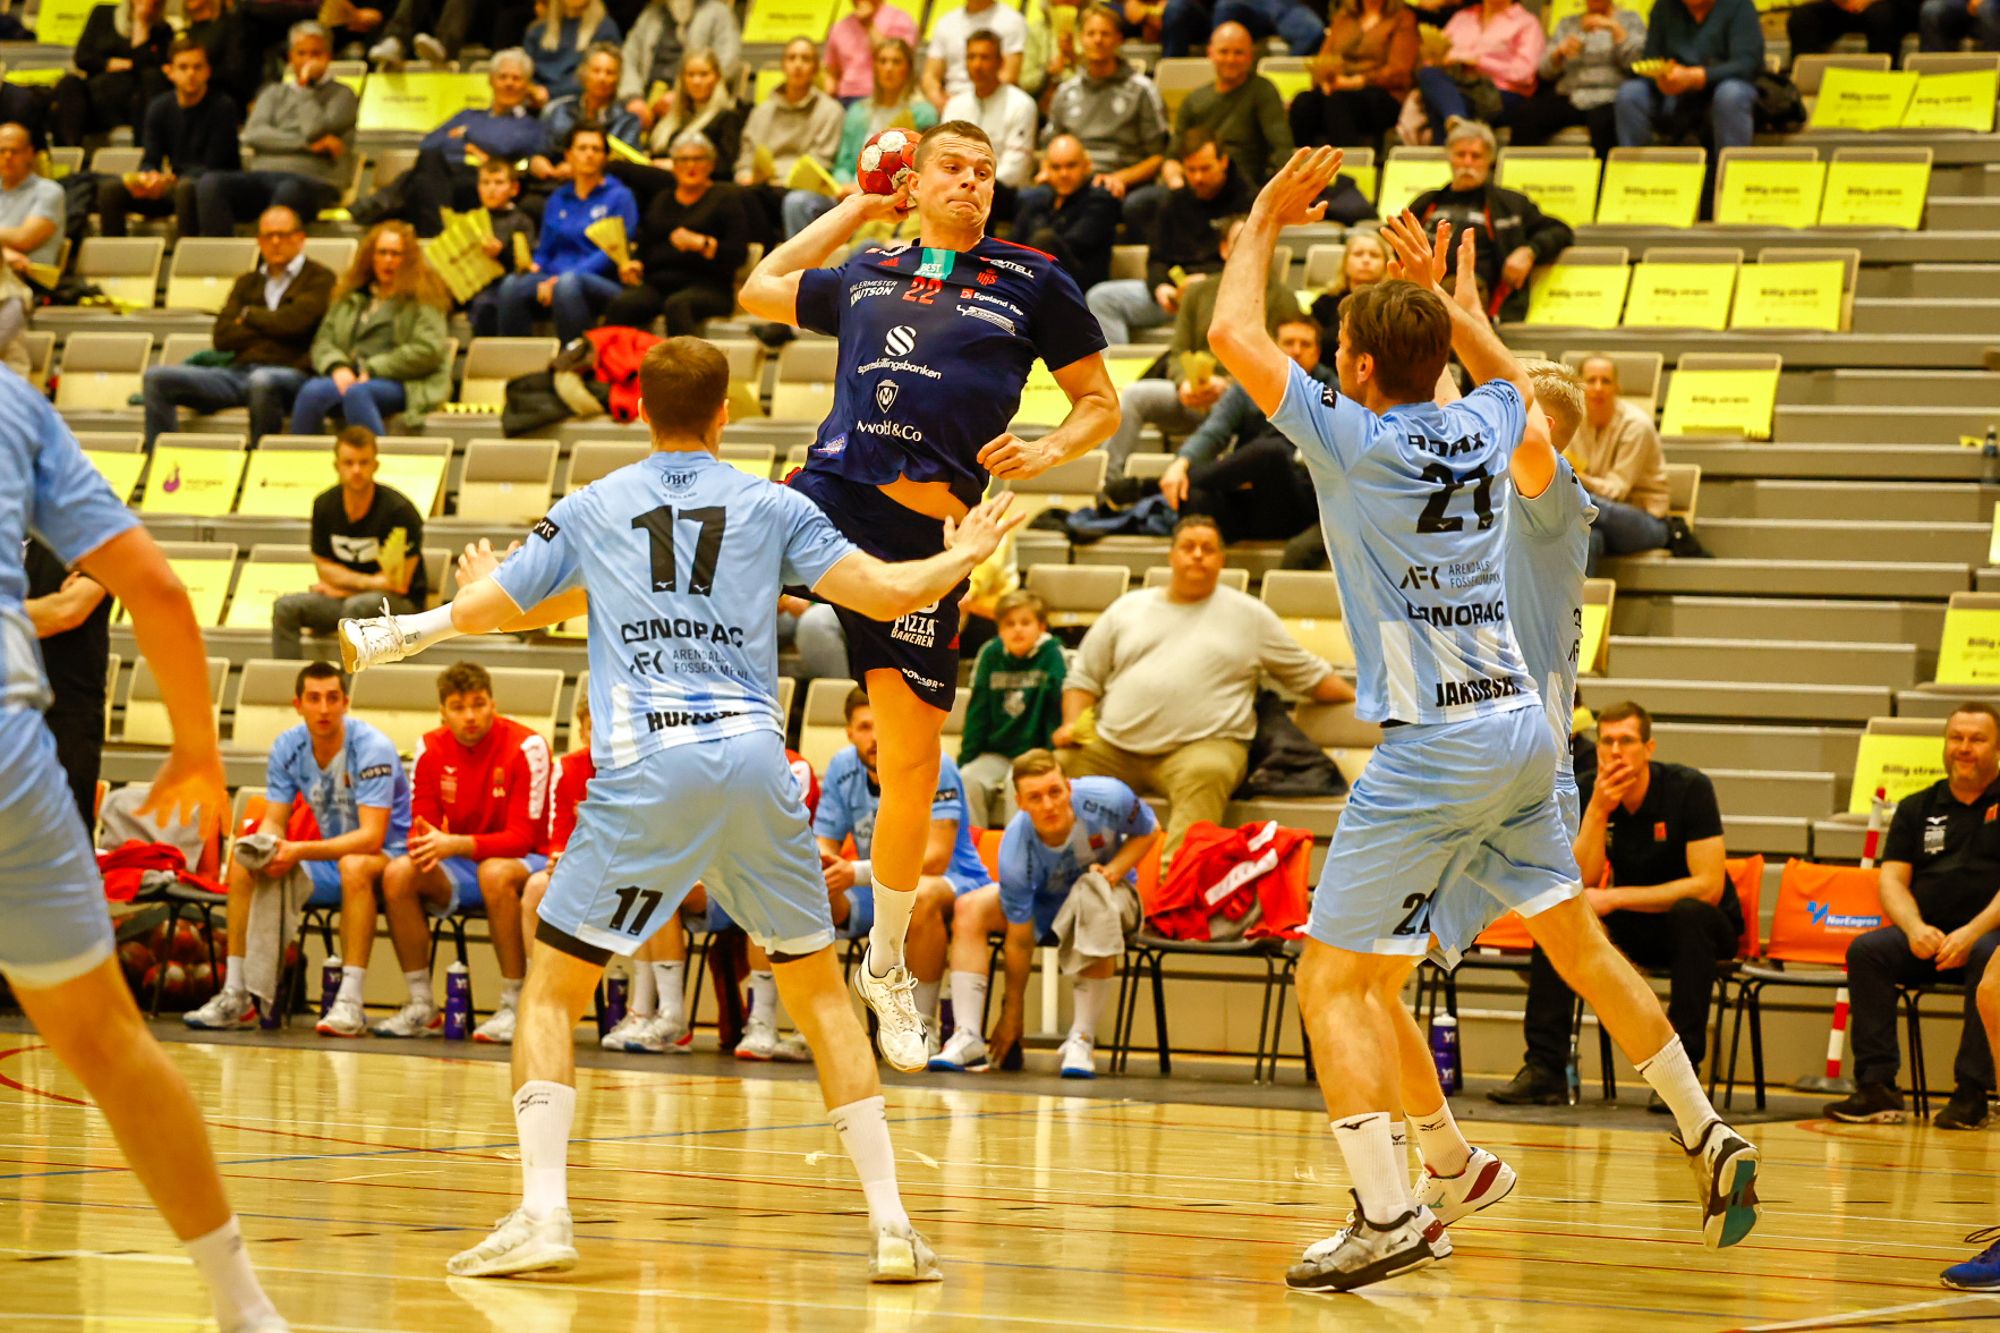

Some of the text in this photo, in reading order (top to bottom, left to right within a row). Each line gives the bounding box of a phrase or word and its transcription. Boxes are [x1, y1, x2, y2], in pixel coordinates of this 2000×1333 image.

[902, 276, 943, 305] 22
[973, 291, 1008, 308] Egeland
[1416, 462, 1495, 533] 21
[631, 505, 726, 597] 17
[890, 627, 935, 648] BAKEREN
[894, 613, 935, 637] PIZZA
[609, 886, 663, 936] 17
